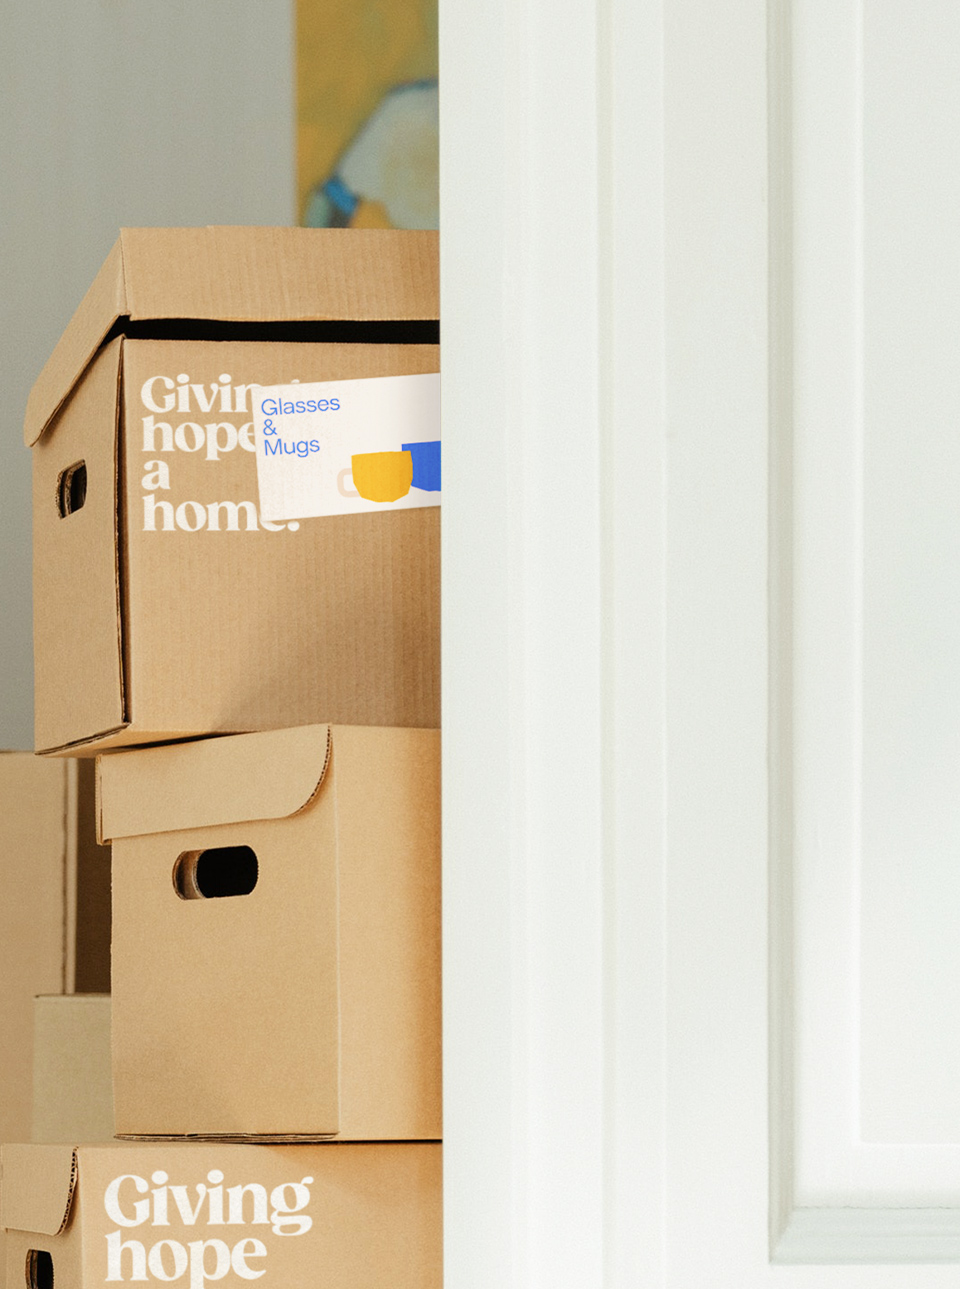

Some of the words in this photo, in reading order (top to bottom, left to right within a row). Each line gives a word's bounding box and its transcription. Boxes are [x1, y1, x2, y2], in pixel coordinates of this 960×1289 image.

[141, 373, 300, 413] Givin
[261, 398, 341, 416] Glasses
[263, 419, 278, 436] &
[264, 438, 321, 458] Mugs
[141, 459, 171, 490] a
[141, 494, 300, 532] hom.
[104, 1169, 314, 1236] Giving
